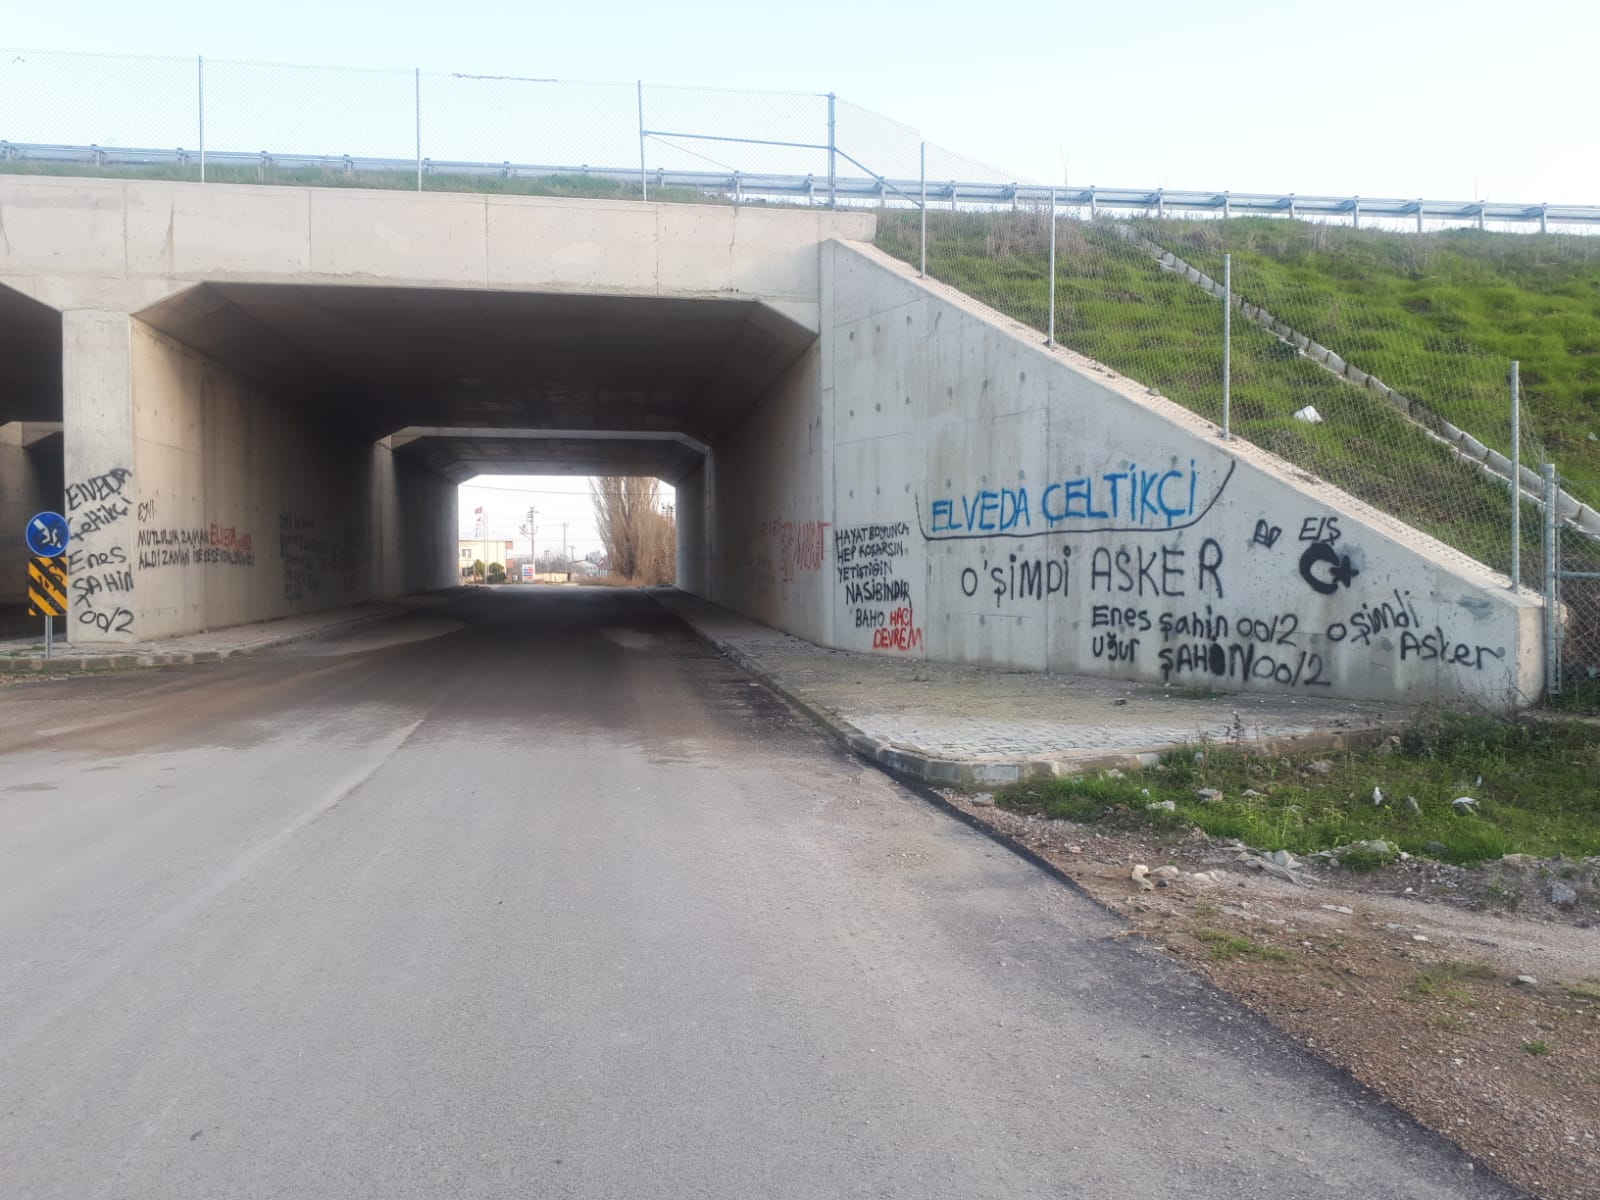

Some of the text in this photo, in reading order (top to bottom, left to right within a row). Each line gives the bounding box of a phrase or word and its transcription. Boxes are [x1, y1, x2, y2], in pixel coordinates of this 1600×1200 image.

[931, 459, 1198, 533] ELVEDA ÇELTİKÇİ
[835, 522, 910, 548] HAYAT BOYUNCA
[67, 546, 127, 576] Enes
[836, 545, 857, 566] HEP
[1091, 538, 1224, 598] ASKER
[855, 608, 884, 628] BAHO
[1092, 605, 1151, 631] Enes
[873, 628, 924, 652] DEVREM
